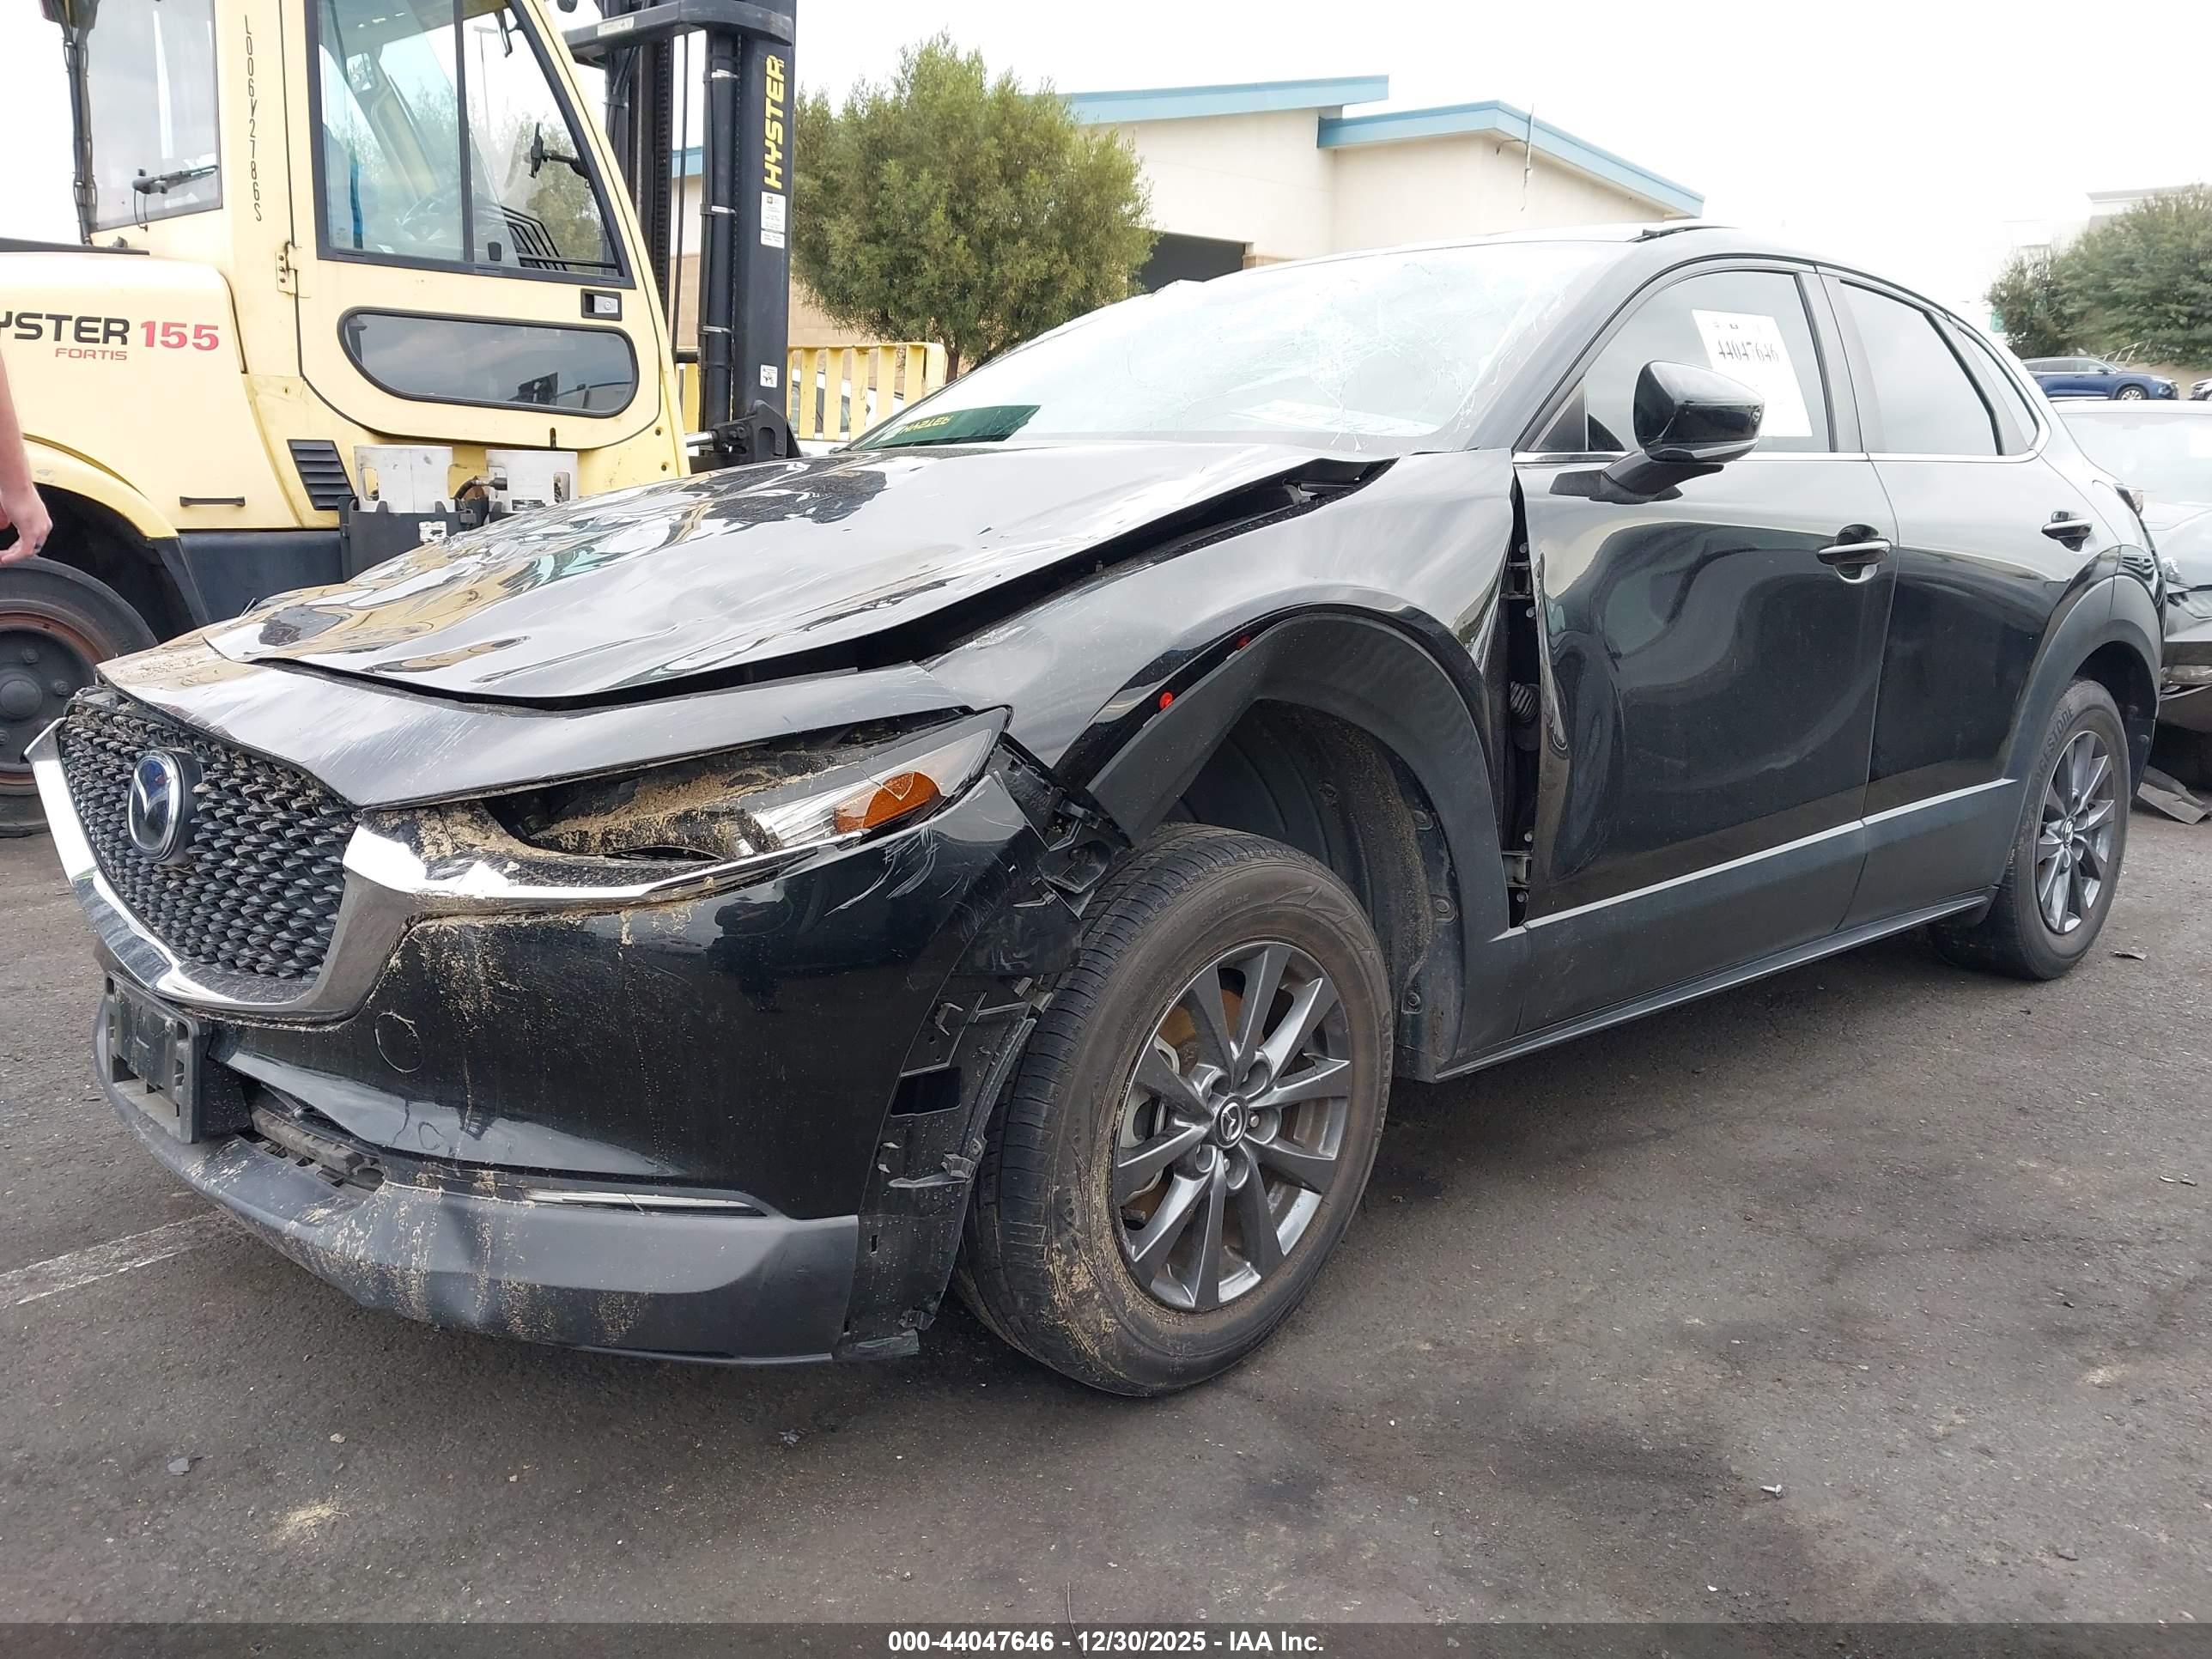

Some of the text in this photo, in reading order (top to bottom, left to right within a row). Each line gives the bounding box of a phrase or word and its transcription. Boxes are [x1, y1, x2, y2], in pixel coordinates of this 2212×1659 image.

[763, 54, 785, 190] HYSTER
[140, 320, 220, 351] 155
[55, 347, 128, 361] FORTIS
[1717, 339, 1779, 362] 44047646
